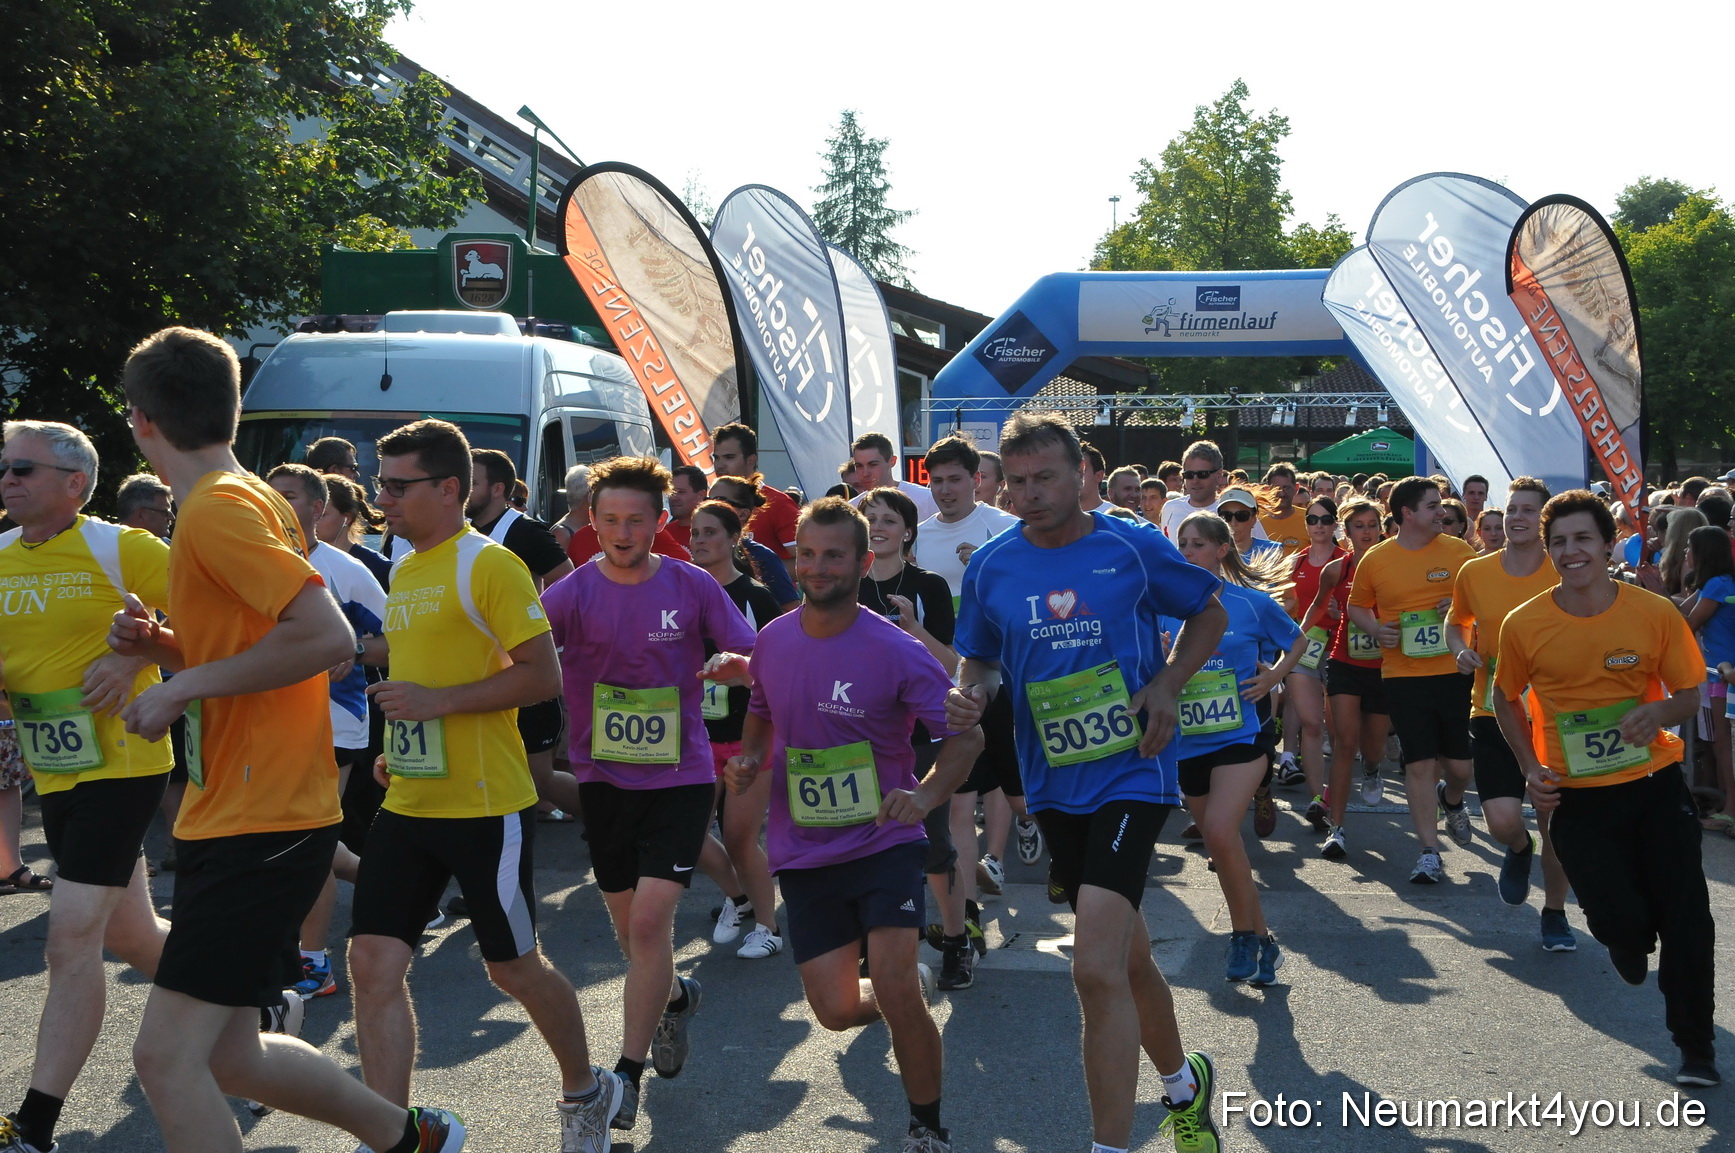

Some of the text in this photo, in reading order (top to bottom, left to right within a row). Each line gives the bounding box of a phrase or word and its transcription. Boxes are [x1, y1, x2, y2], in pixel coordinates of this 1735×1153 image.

[470, 293, 495, 303] 1628
[1205, 295, 1238, 303] Fischer
[1180, 311, 1279, 330] firmenlauf
[994, 345, 1046, 357] Fischer
[0, 572, 92, 588] AGNA STEYR
[57, 585, 92, 599] 2014
[411, 585, 446, 600] STEYR
[417, 602, 440, 615] 2014
[1026, 595, 1042, 624] I
[661, 610, 679, 629] K
[1031, 618, 1102, 639] camping
[1077, 638, 1102, 647] Berger
[1414, 626, 1440, 645] 45
[1201, 659, 1224, 670] ping
[832, 680, 853, 703] K
[818, 702, 865, 714] KÜFNER
[1180, 697, 1238, 727] 5044
[23, 720, 83, 754] 736
[387, 720, 427, 755] 731
[605, 712, 666, 744] 609
[1044, 704, 1134, 754] 5036
[1585, 729, 1625, 759] 52
[799, 772, 860, 807] 611
